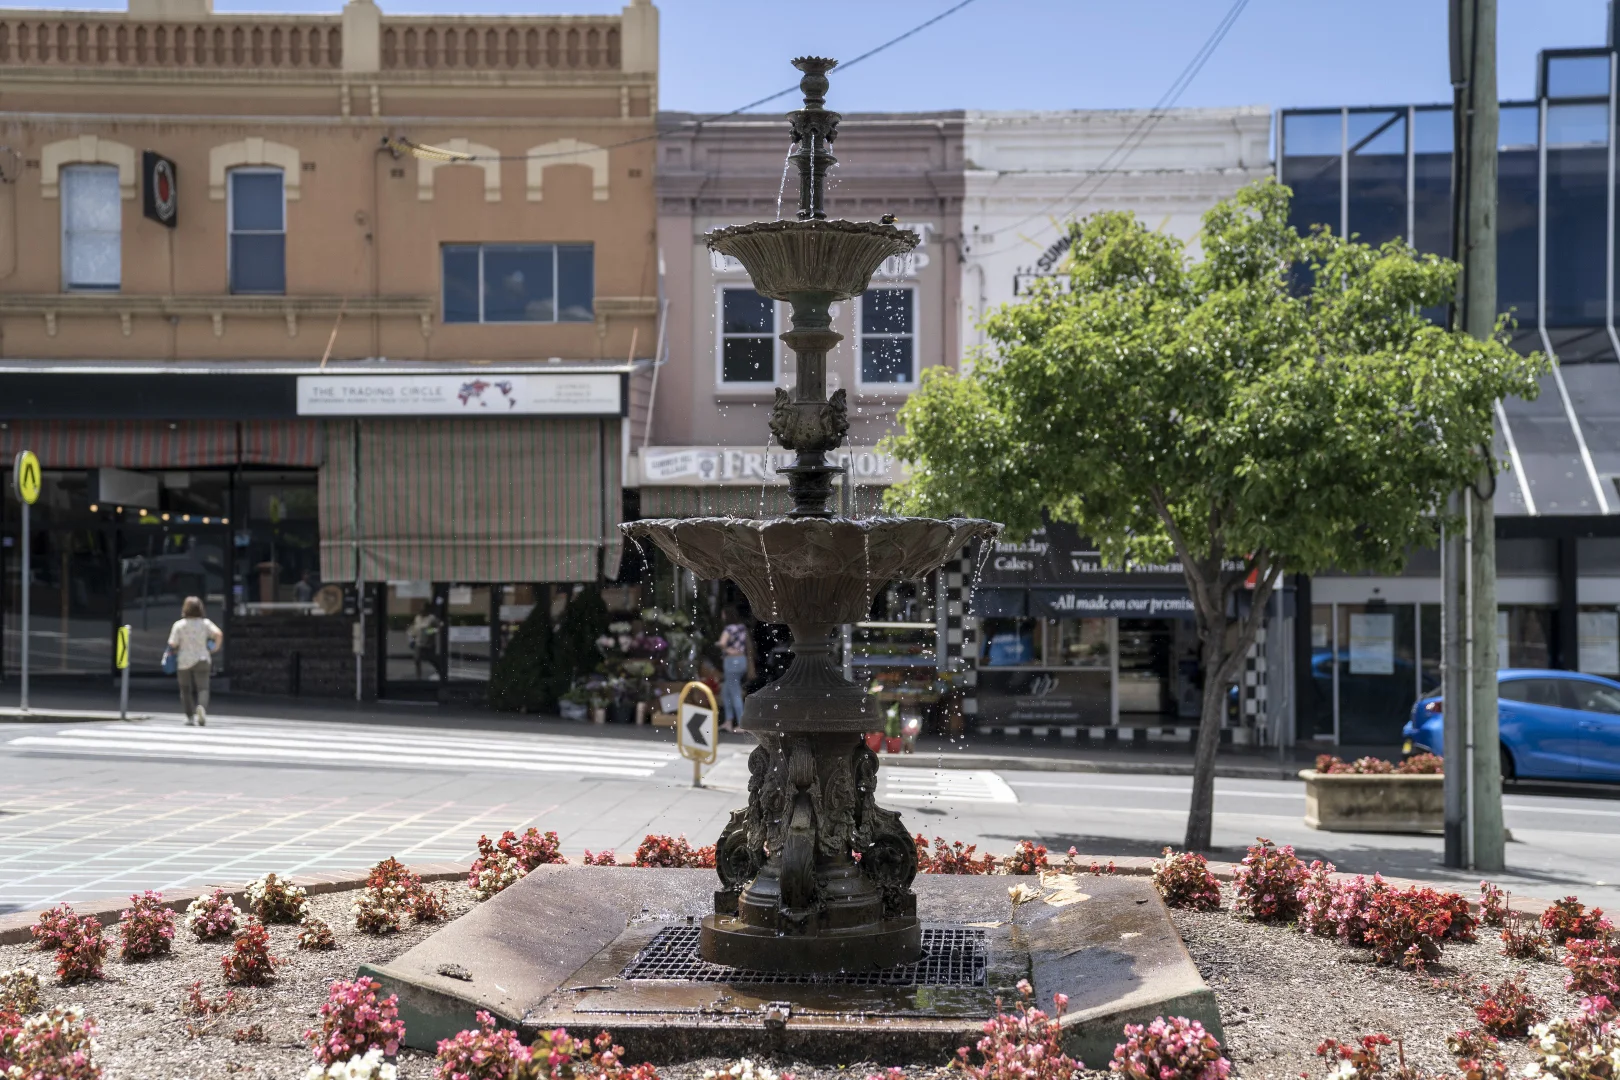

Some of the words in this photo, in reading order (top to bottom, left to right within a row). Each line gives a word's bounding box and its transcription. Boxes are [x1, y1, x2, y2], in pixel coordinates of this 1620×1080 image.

[312, 386, 334, 396] THE
[342, 386, 394, 396] TRADING
[400, 386, 443, 396] CIRCLE
[994, 553, 1034, 571] Cakes
[1076, 595, 1109, 610] made
[1109, 600, 1126, 610] on
[1127, 599, 1149, 610] our
